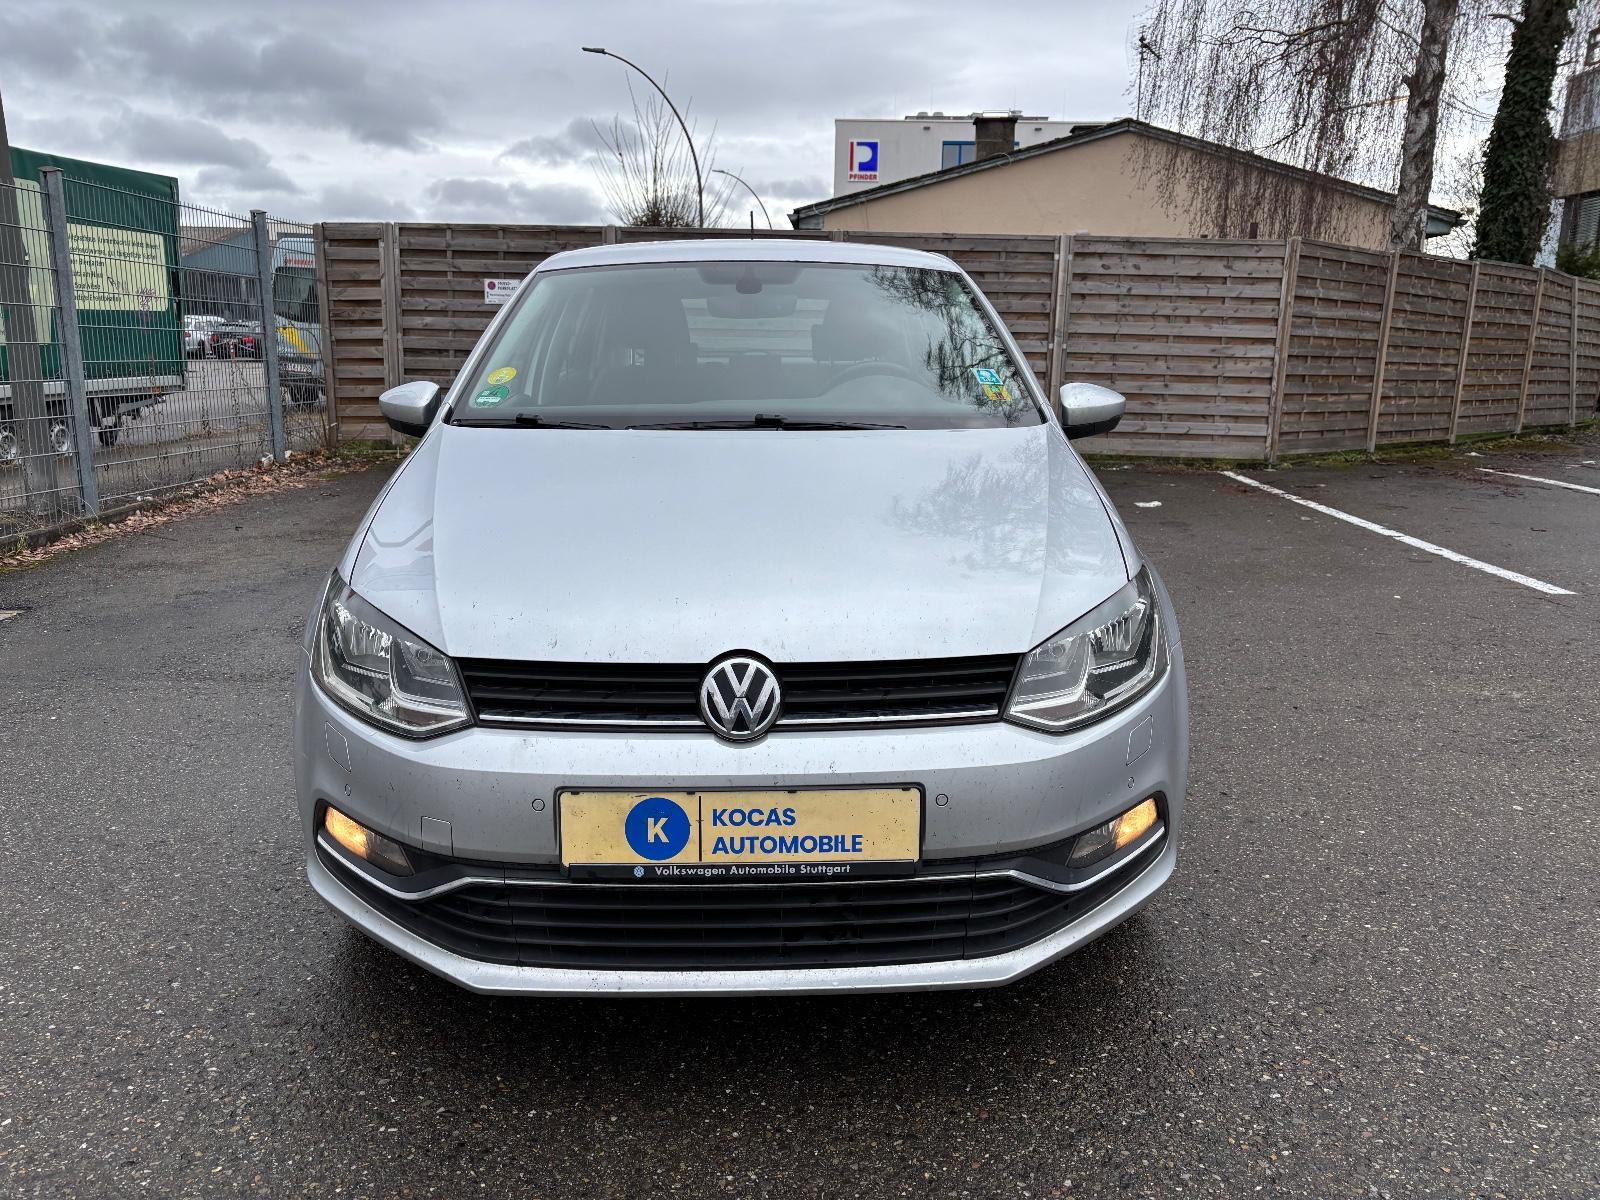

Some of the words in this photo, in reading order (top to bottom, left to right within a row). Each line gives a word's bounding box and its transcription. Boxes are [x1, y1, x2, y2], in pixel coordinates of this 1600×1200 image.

[700, 657, 781, 736] VW
[647, 817, 669, 843] K
[711, 834, 864, 855] AUTOMOBILE
[654, 865, 726, 877] Volkswagen
[729, 864, 797, 875] Automobile
[800, 864, 851, 876] Stuttgart
